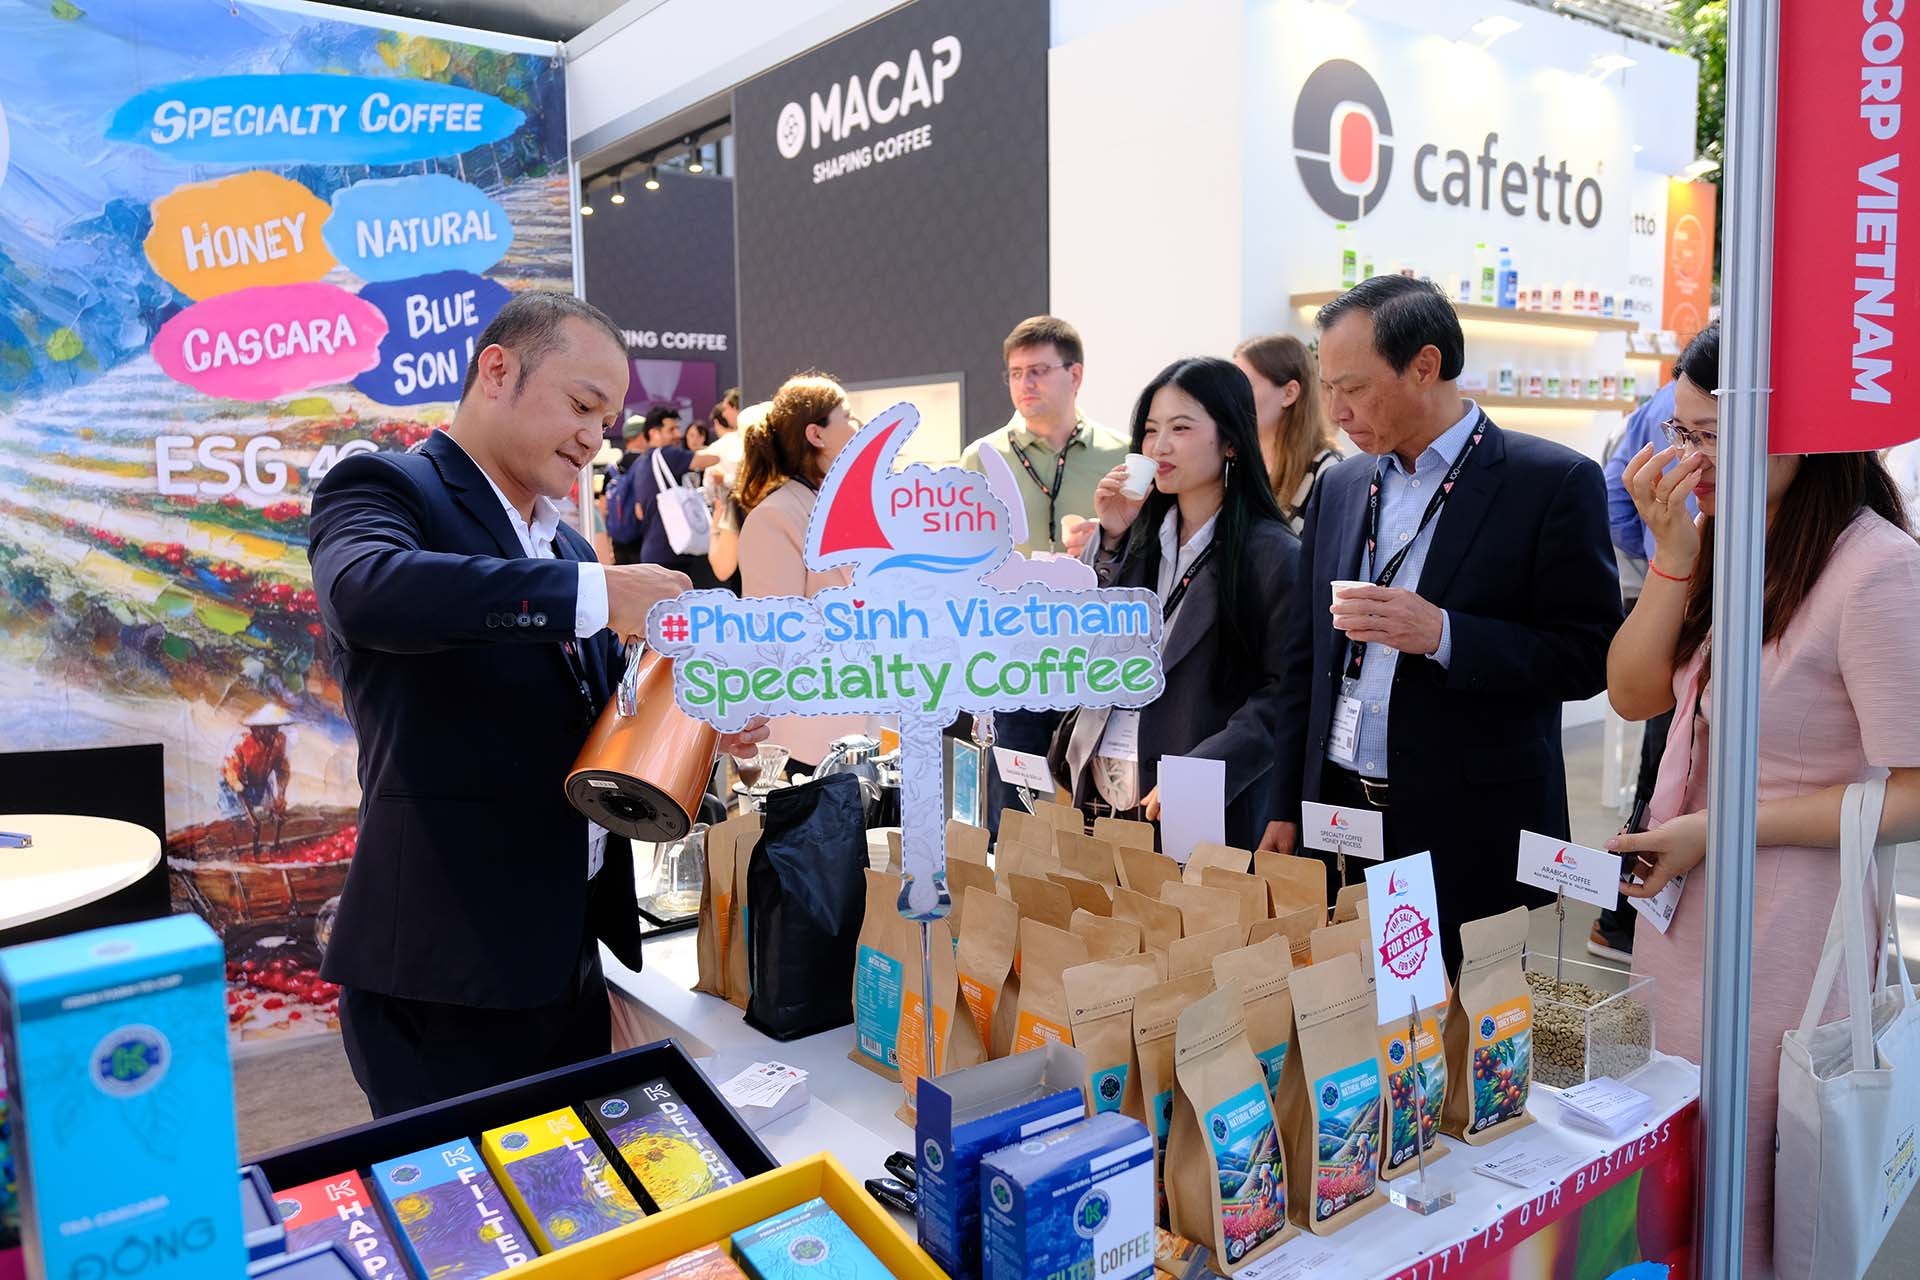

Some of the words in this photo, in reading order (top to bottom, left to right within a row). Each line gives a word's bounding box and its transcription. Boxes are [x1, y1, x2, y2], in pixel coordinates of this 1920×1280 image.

[810, 35, 962, 150] MACAP
[812, 147, 872, 184] SHAPING
[874, 124, 932, 164] COFFEE
[1413, 132, 1602, 228] cafetto
[181, 213, 306, 273] HONEY
[356, 211, 498, 259] NATURAL
[1850, 153, 1900, 404] VIETNAM
[406, 290, 480, 339] BLUE
[182, 313, 357, 373] CASCARA
[661, 331, 728, 351] COFFEE
[393, 349, 459, 396] SON
[154, 434, 288, 497] ESG
[890, 479, 975, 517] phúc
[922, 504, 996, 533] sinh
[661, 605, 806, 645] #Phuc
[824, 599, 929, 642] Sinh
[945, 597, 1148, 642] Vietnam
[683, 654, 951, 716] Specialty
[965, 647, 1156, 699] Coffee
[1541, 866, 1567, 879] ARABICA
[1568, 873, 1592, 886] COFFEE
[1387, 939, 1404, 959] FOR
[1403, 926, 1425, 948] SALE
[1390, 917, 1399, 933] FOR
[1399, 913, 1413, 923] SALE
[1408, 951, 1421, 968] SALE
[1483, 1218, 1505, 1248] IS
[1519, 1186, 1561, 1227] OUR
[1575, 1123, 1671, 1194] BUSINESS
[336, 1201, 394, 1280] HAPP
[1100, 1231, 1151, 1275] COFFEE
